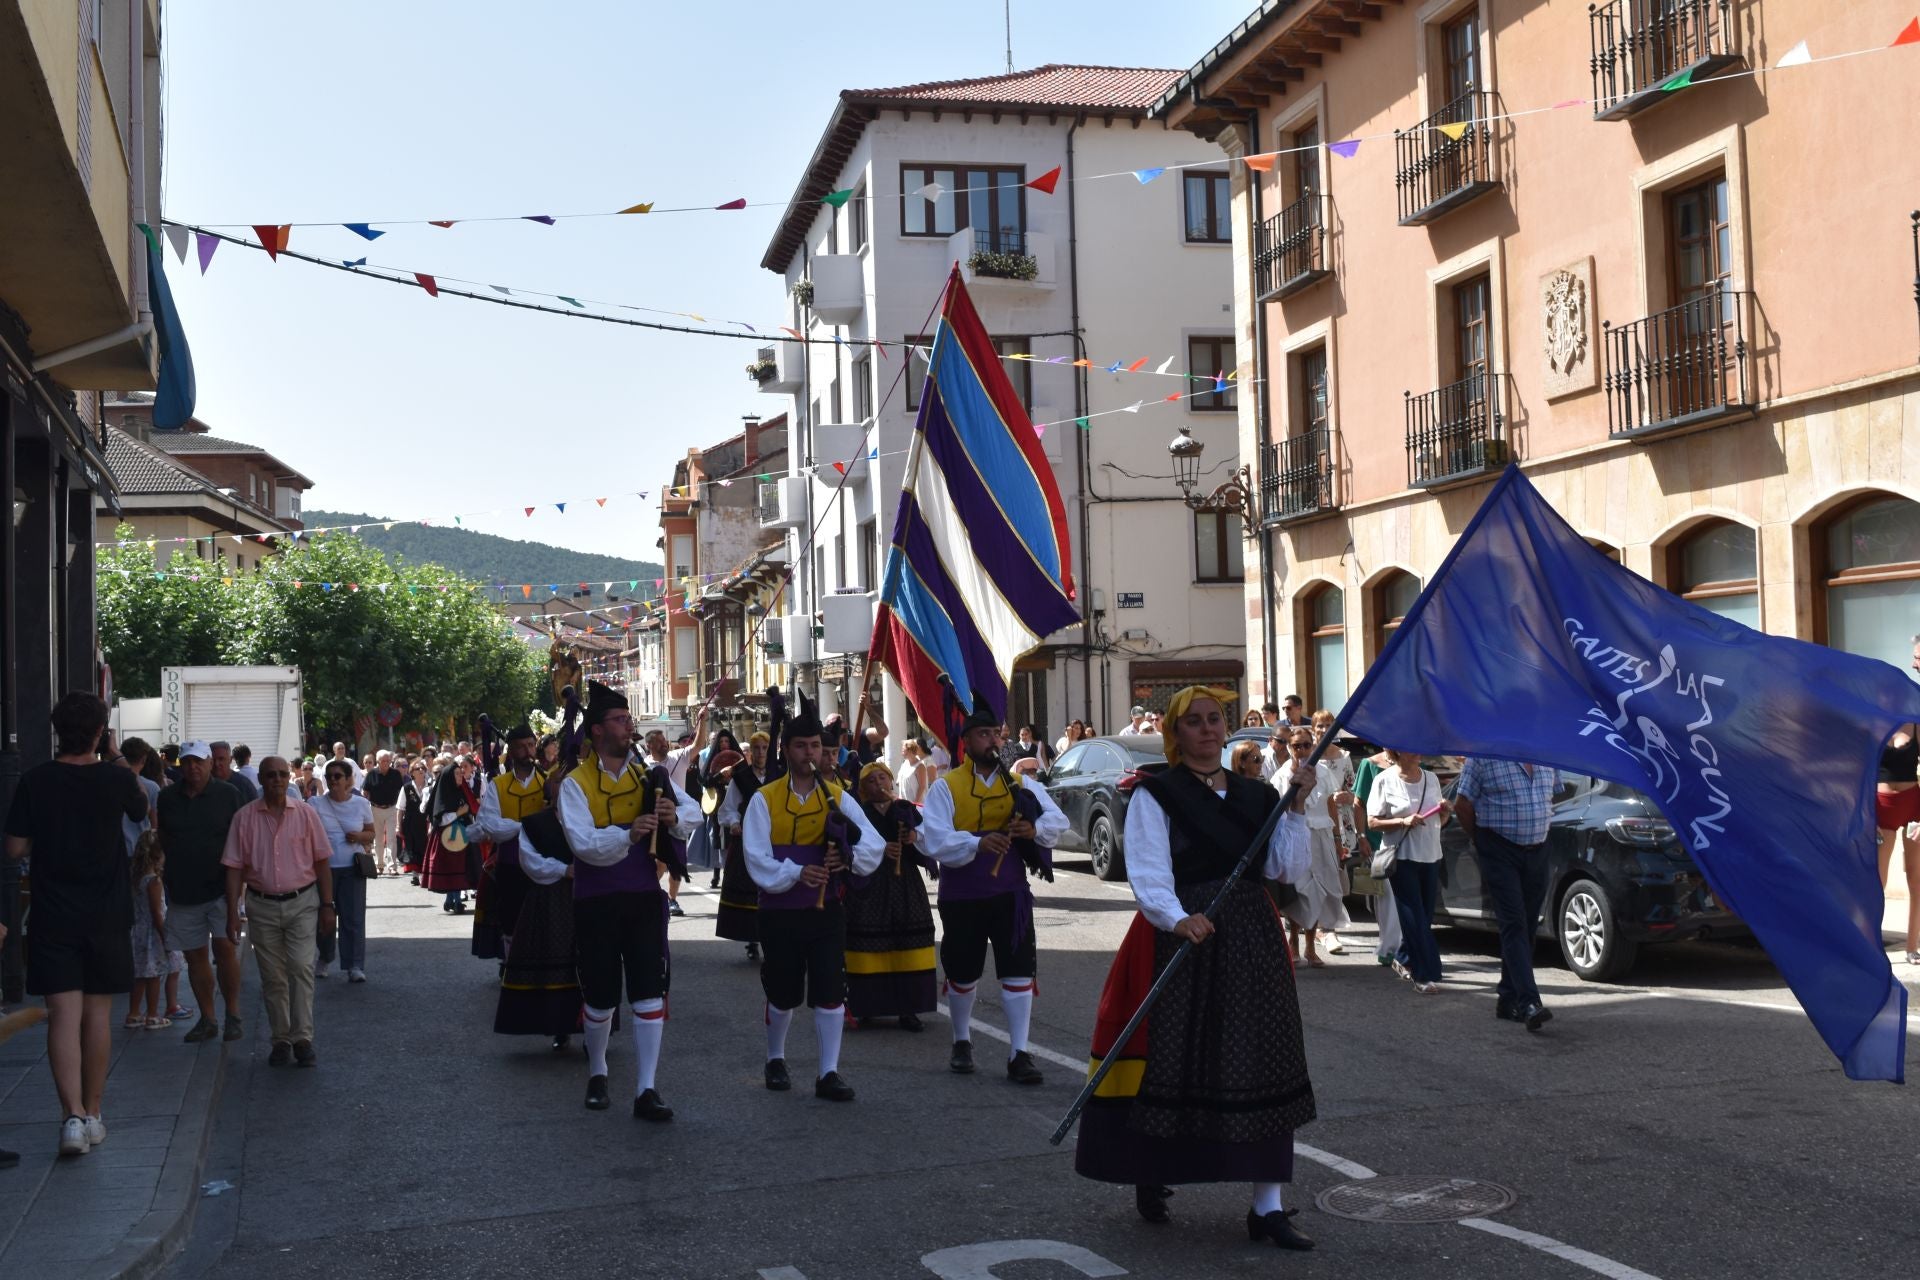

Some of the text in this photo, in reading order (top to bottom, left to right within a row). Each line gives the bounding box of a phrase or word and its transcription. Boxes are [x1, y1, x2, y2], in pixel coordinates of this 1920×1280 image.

[1563, 617, 1651, 684] GAITES
[1676, 668, 1699, 699] LA
[167, 671, 180, 745] DOMINGO
[1686, 674, 1732, 850] LAGUNA
